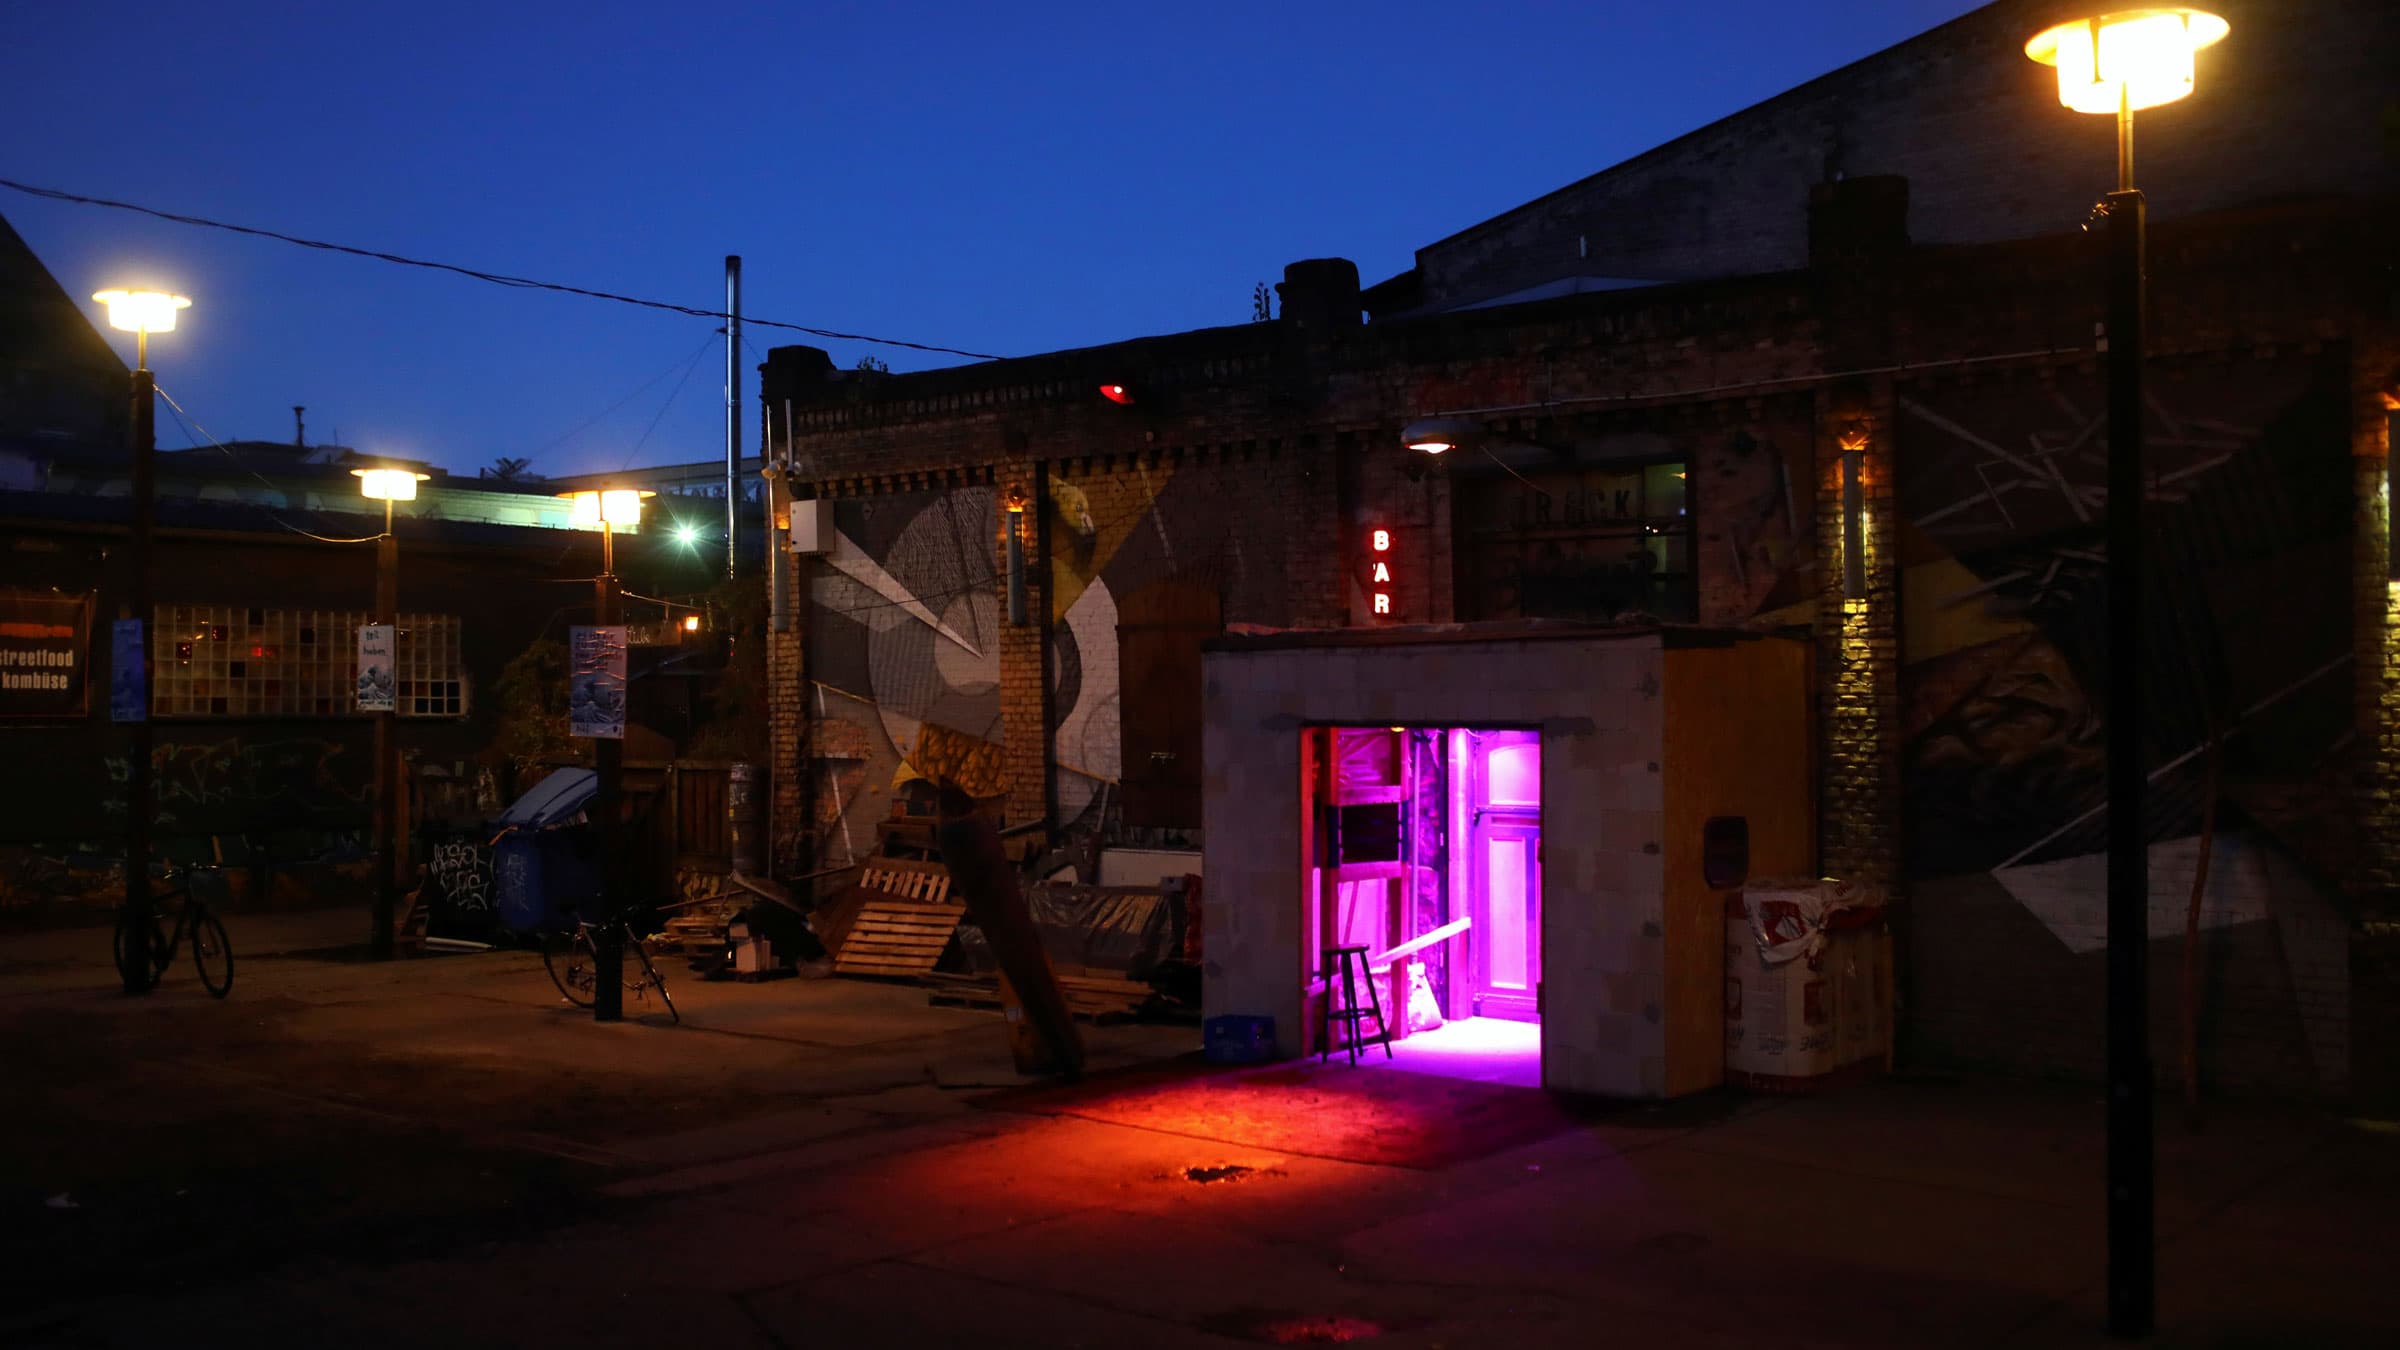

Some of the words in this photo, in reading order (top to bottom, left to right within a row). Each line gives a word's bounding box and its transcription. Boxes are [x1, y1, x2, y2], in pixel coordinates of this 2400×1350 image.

[1374, 530, 1390, 614] BAR
[0, 648, 74, 667] treetfood
[2, 671, 68, 689] kombüse
